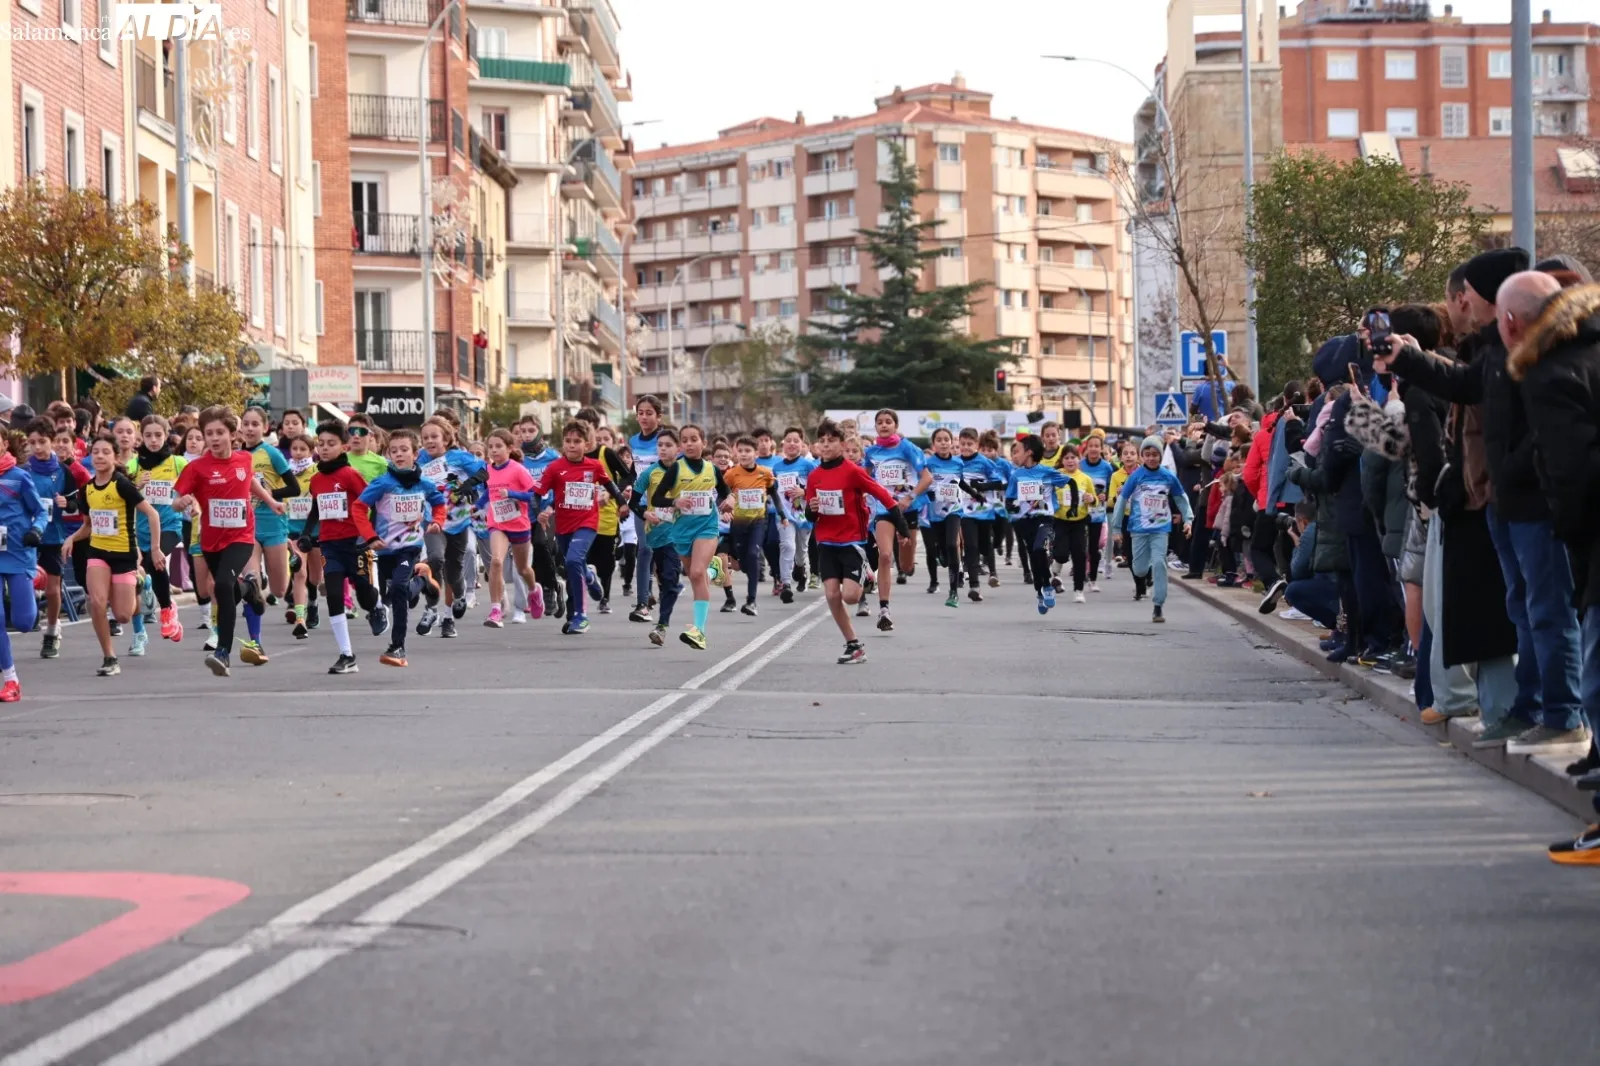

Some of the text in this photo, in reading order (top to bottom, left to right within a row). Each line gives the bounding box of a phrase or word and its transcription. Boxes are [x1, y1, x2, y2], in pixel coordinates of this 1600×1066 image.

[1189, 337, 1217, 372] P
[381, 397, 424, 415] ANTONIO
[881, 470, 899, 479] 6452
[145, 487, 167, 497] 6450
[320, 499, 339, 511] 6448
[395, 501, 418, 513] 6383
[819, 497, 836, 506] 442
[213, 506, 239, 518] 6538
